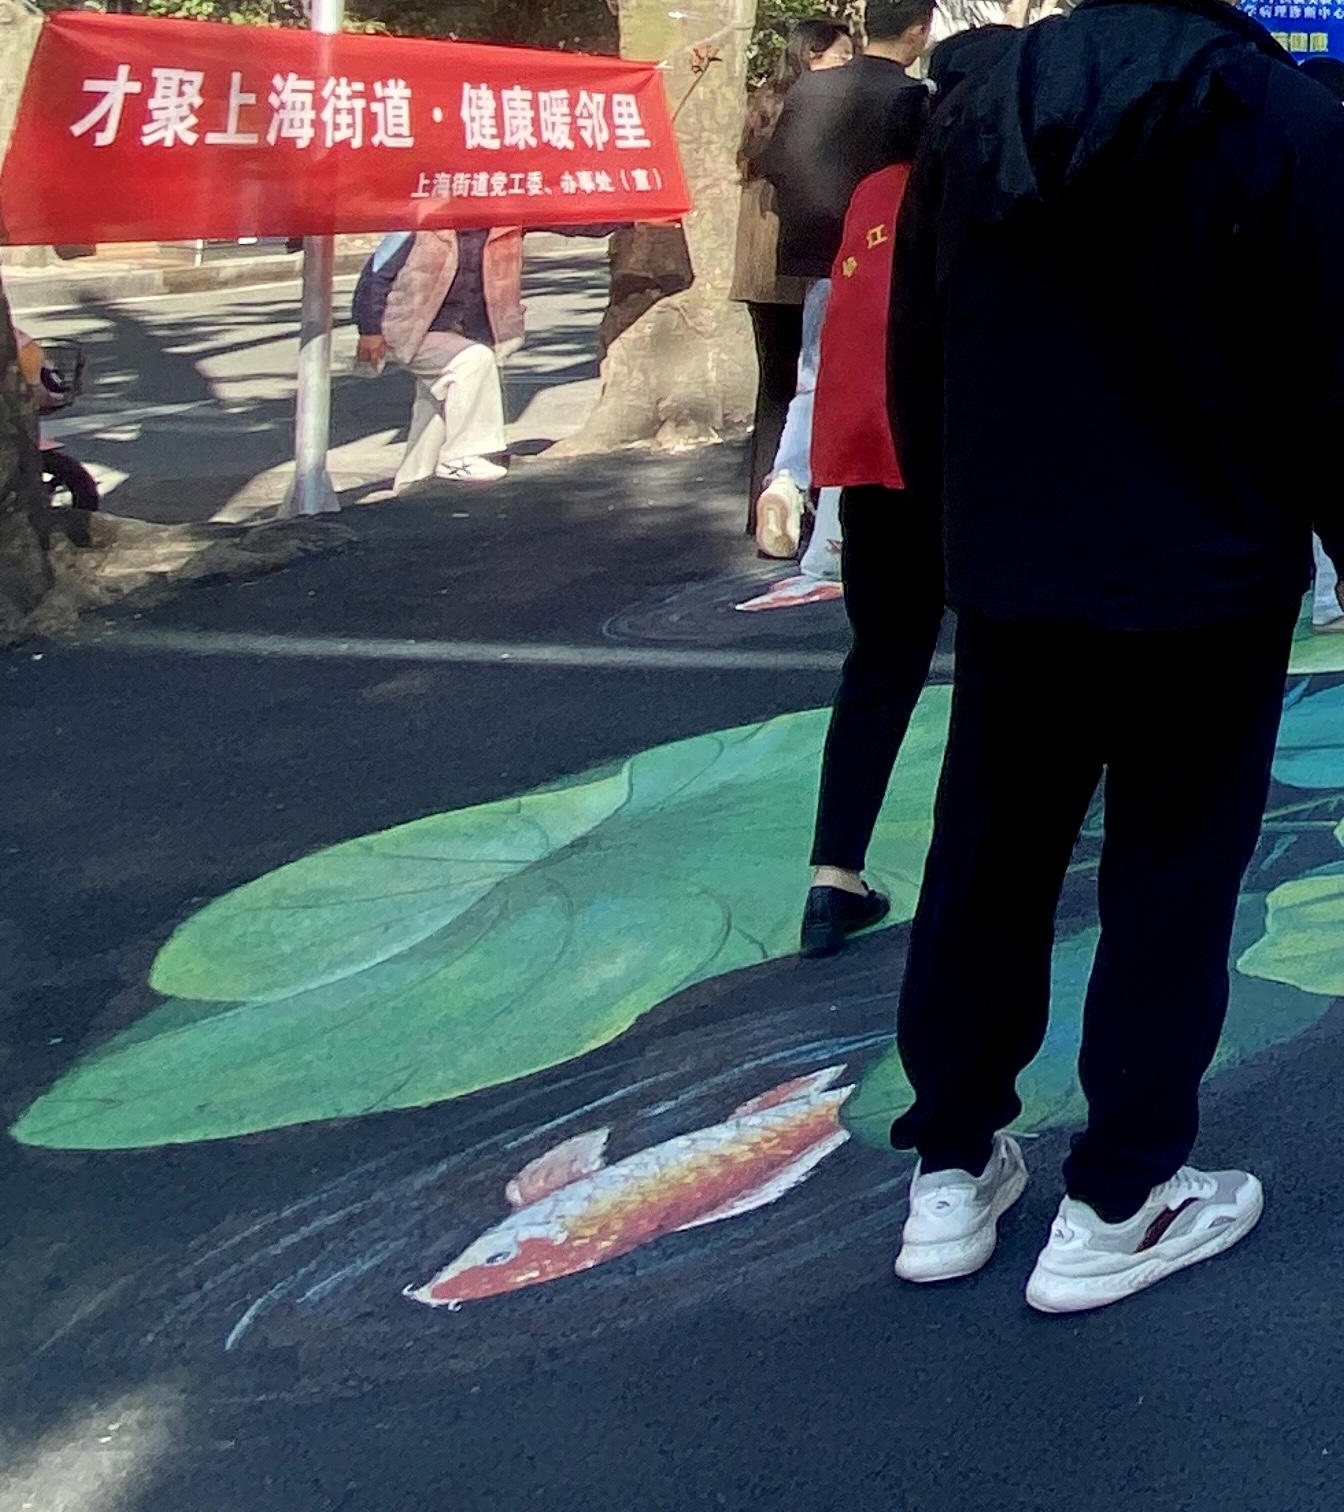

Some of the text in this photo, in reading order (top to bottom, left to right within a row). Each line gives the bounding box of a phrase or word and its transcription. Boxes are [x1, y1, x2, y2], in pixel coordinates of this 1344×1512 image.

[68, 63, 652, 152] 才聚上海街道·健康暖邻里
